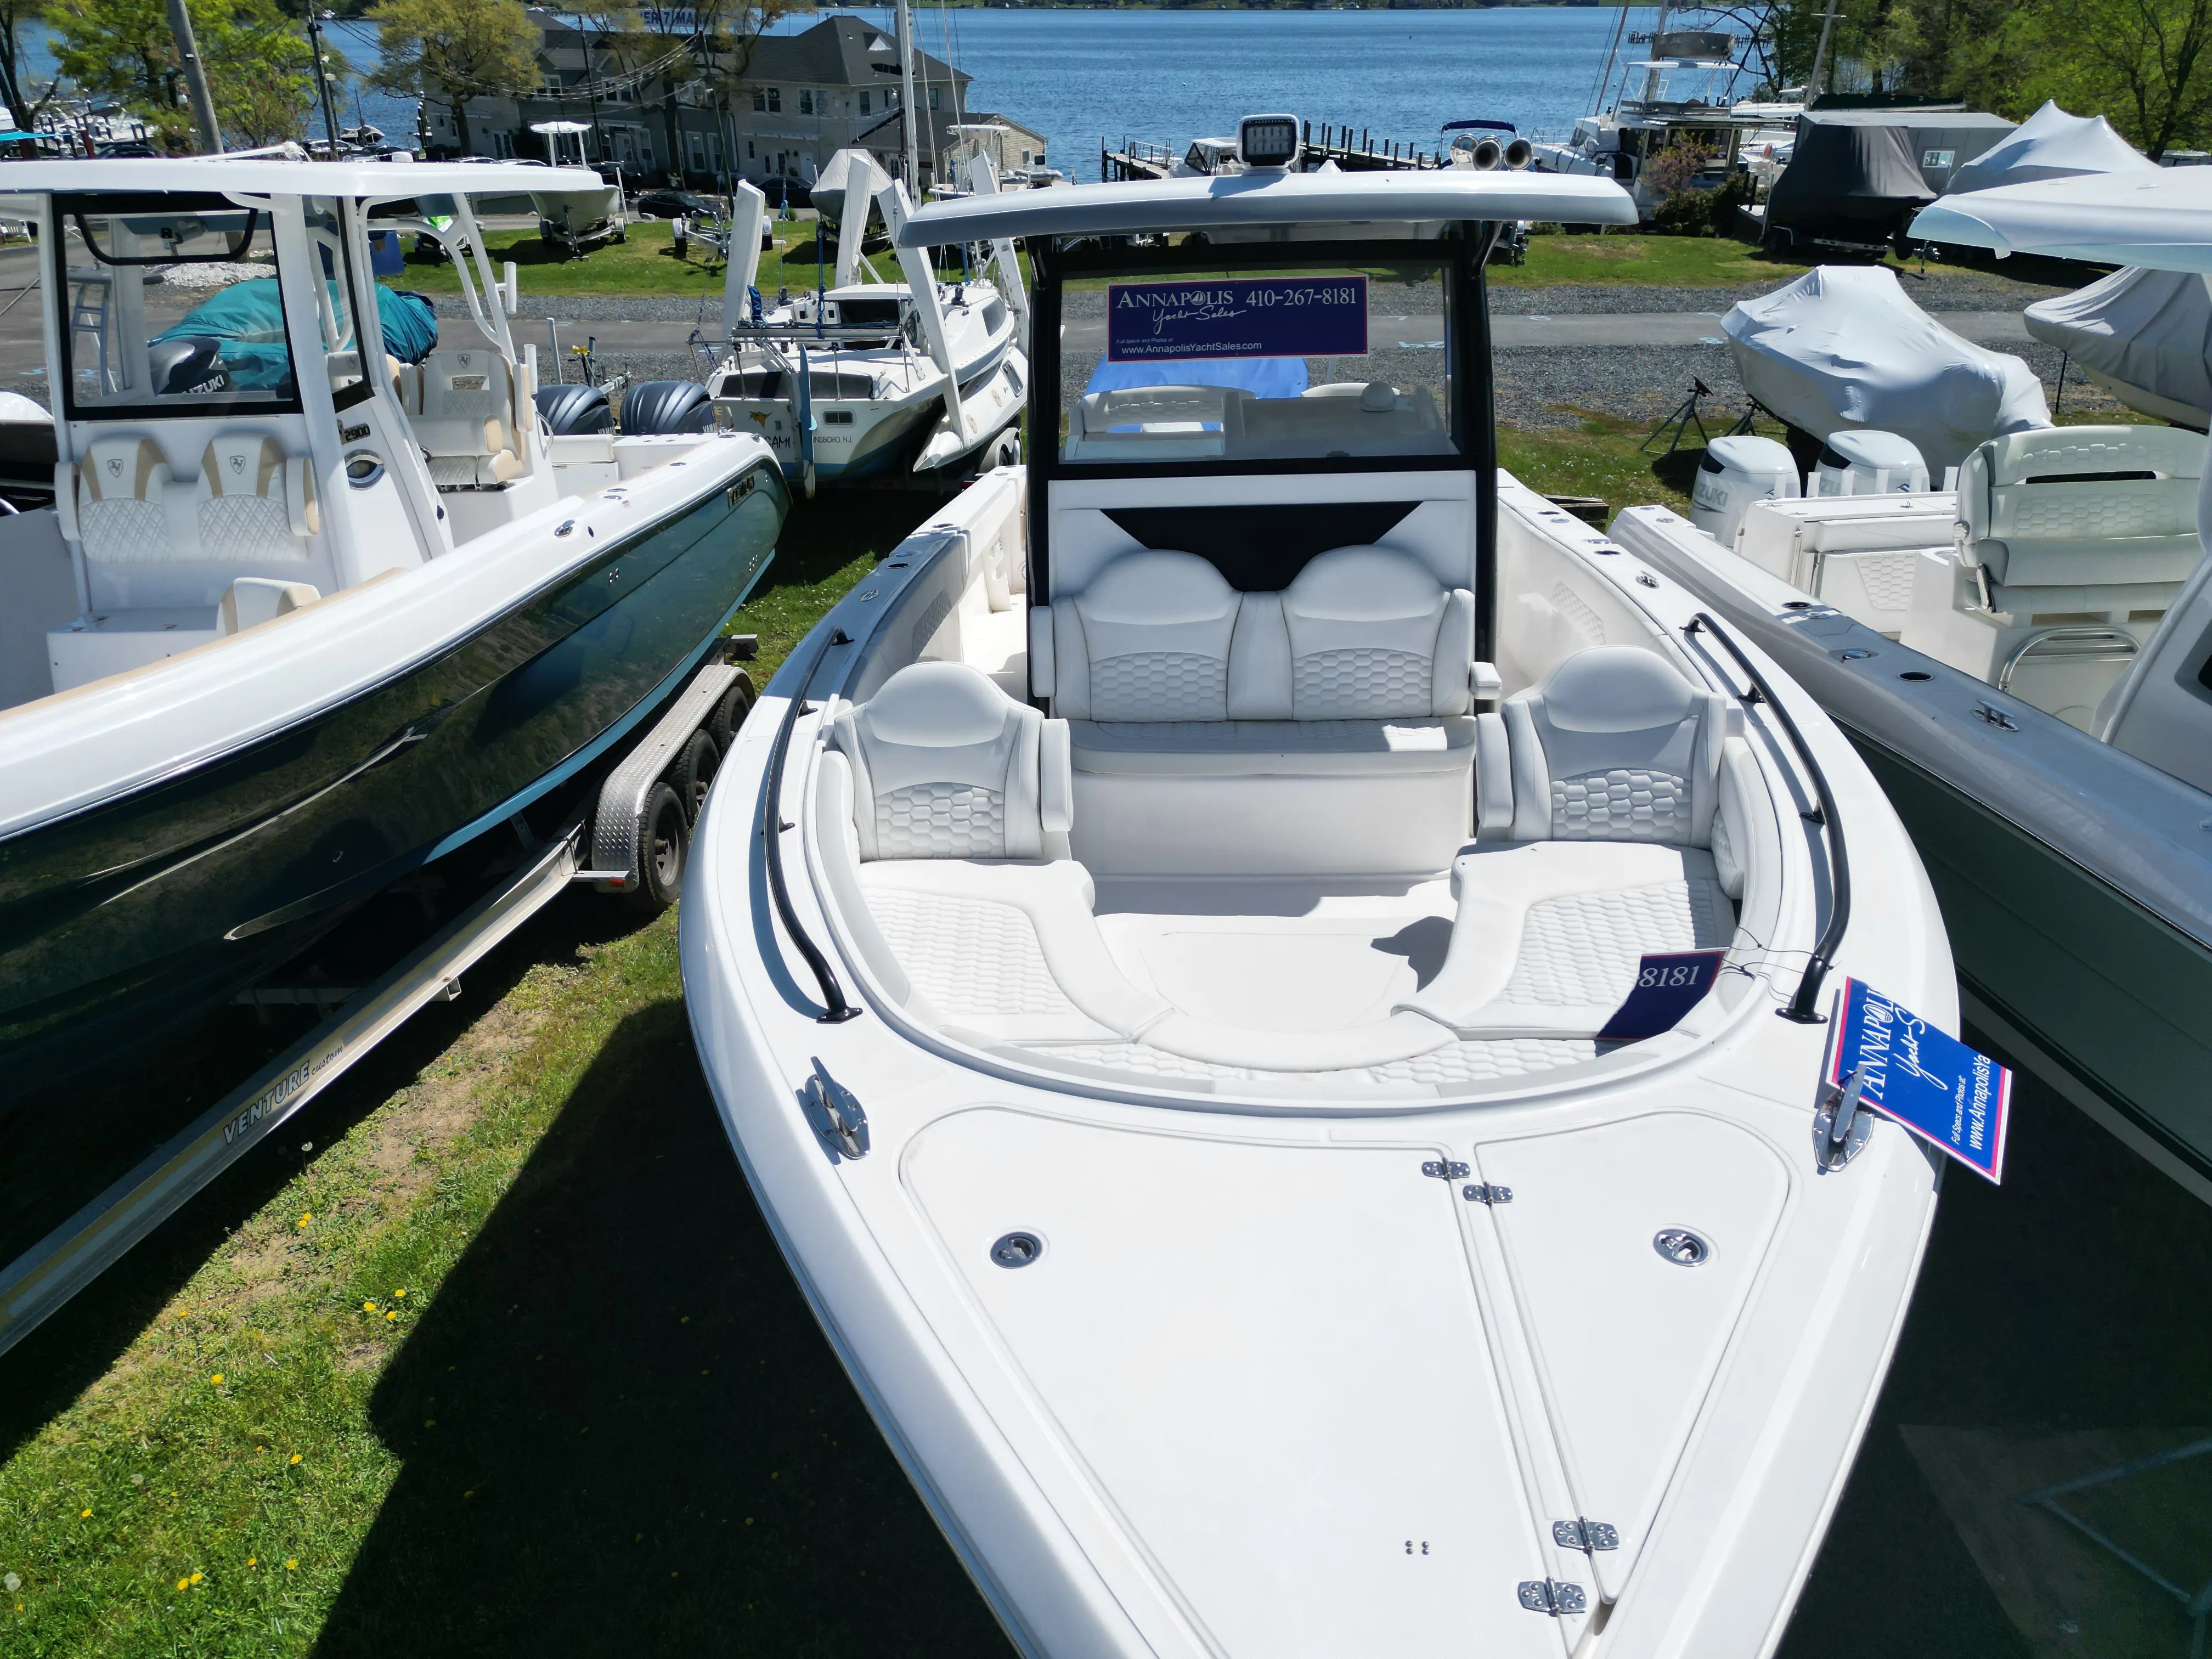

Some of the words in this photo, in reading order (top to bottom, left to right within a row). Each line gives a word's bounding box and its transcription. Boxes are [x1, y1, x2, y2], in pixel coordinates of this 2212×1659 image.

[1116, 290, 1233, 308] ANNAPOLIS
[1246, 287, 1357, 307] 410-267-8181
[1153, 308, 1199, 335] Yacht
[1195, 304, 1247, 320] Sales
[1121, 341, 1262, 354] www.AnnapolisYachtSales.com
[343, 425, 371, 442] 2900
[223, 1059, 311, 1146] VENTURE
[311, 1045, 344, 1076] custom
[1955, 1083, 1966, 1104] Photos
[1955, 1101, 1964, 1115] and
[1951, 1114, 1963, 1133] Specs
